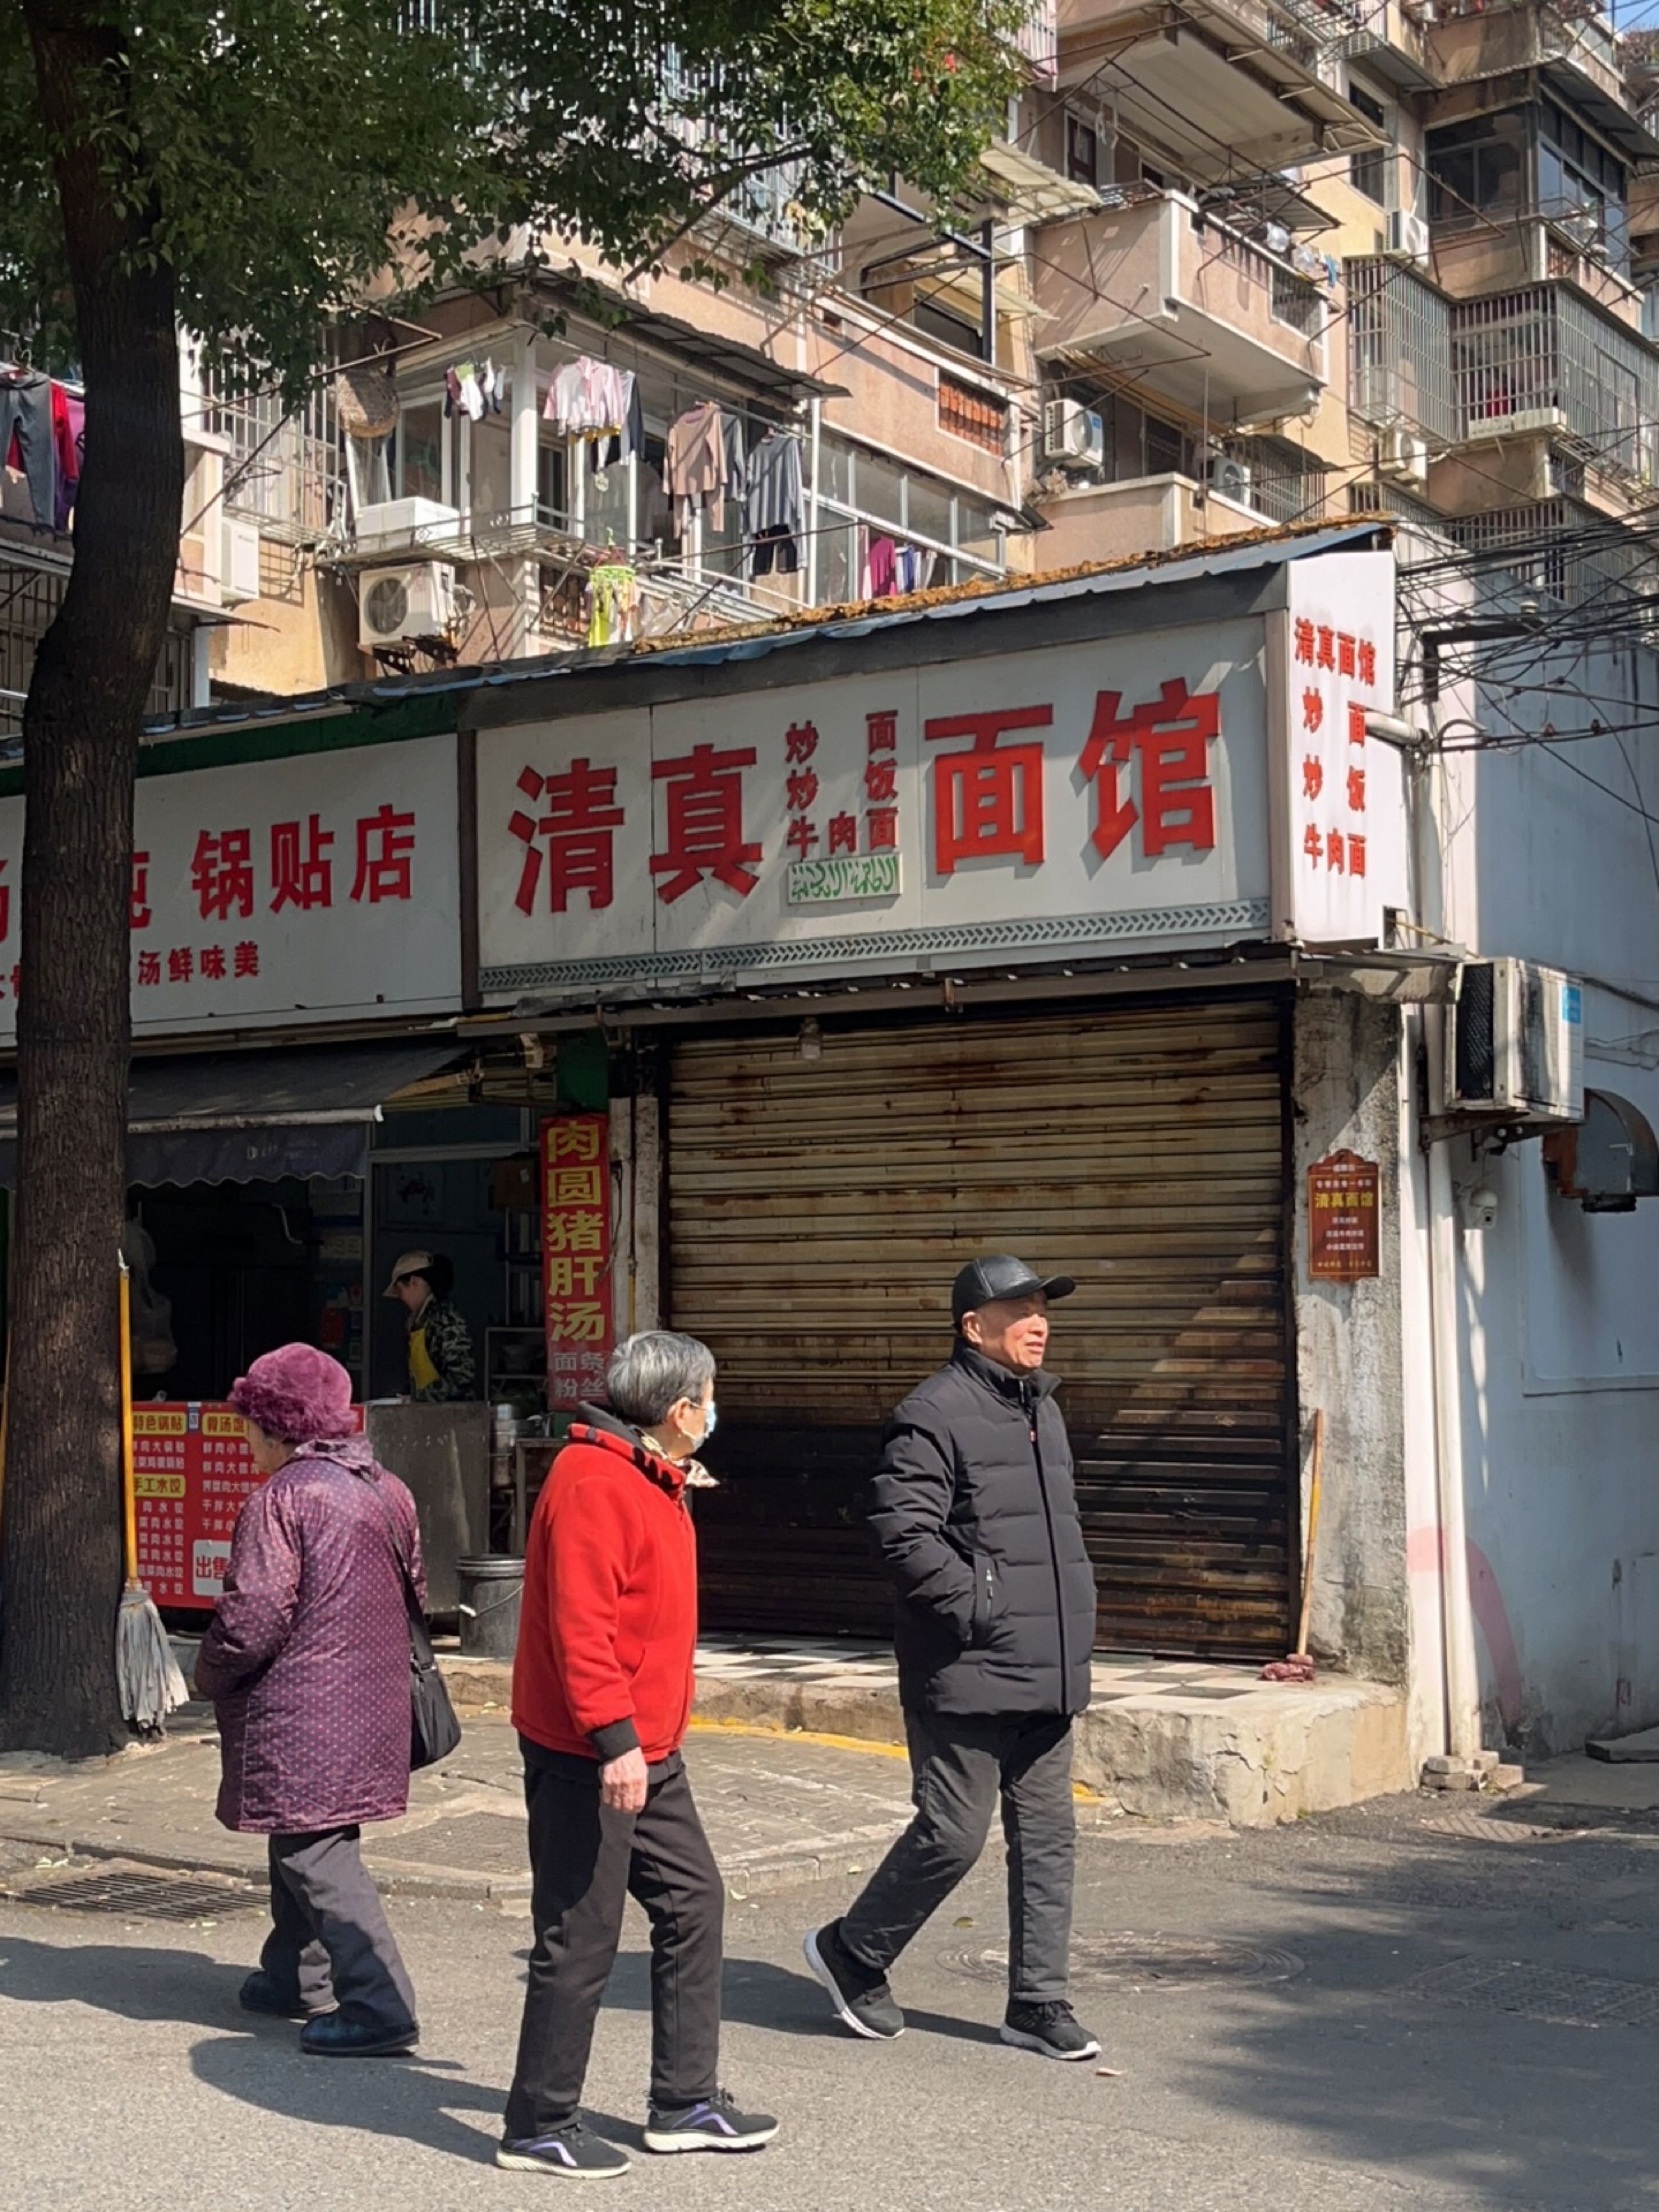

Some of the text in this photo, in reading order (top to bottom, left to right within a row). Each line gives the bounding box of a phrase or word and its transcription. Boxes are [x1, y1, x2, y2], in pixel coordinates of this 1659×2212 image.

[1295, 617, 1375, 687] 清真面馆
[508, 677, 1221, 916] 清真 面馆
[787, 806, 899, 859] 牛肉面
[1304, 823, 1366, 879] 牛肉面
[192, 804, 415, 921] 锅贴店
[137, 941, 260, 986] 汤鲜味美
[547, 1121, 605, 1342] 肉圆猪肝汤
[554, 1351, 605, 1372] 面条
[554, 1377, 605, 1399] 粉丝
